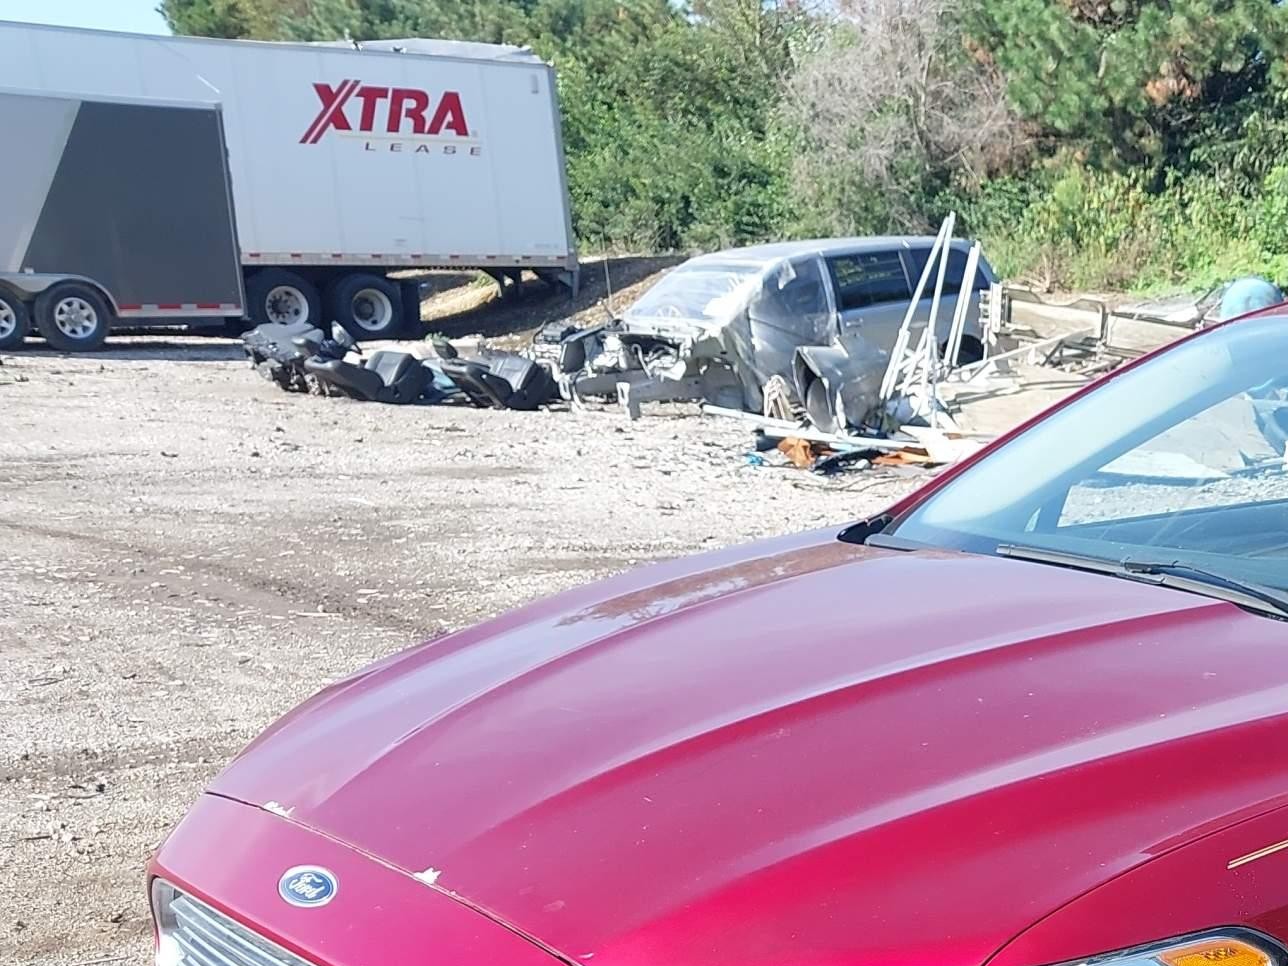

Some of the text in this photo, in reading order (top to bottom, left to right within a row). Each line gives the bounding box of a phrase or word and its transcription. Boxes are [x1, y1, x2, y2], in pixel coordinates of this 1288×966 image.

[299, 79, 469, 144] XTRA
[364, 141, 481, 156] LEASE
[288, 873, 326, 899] Ford
